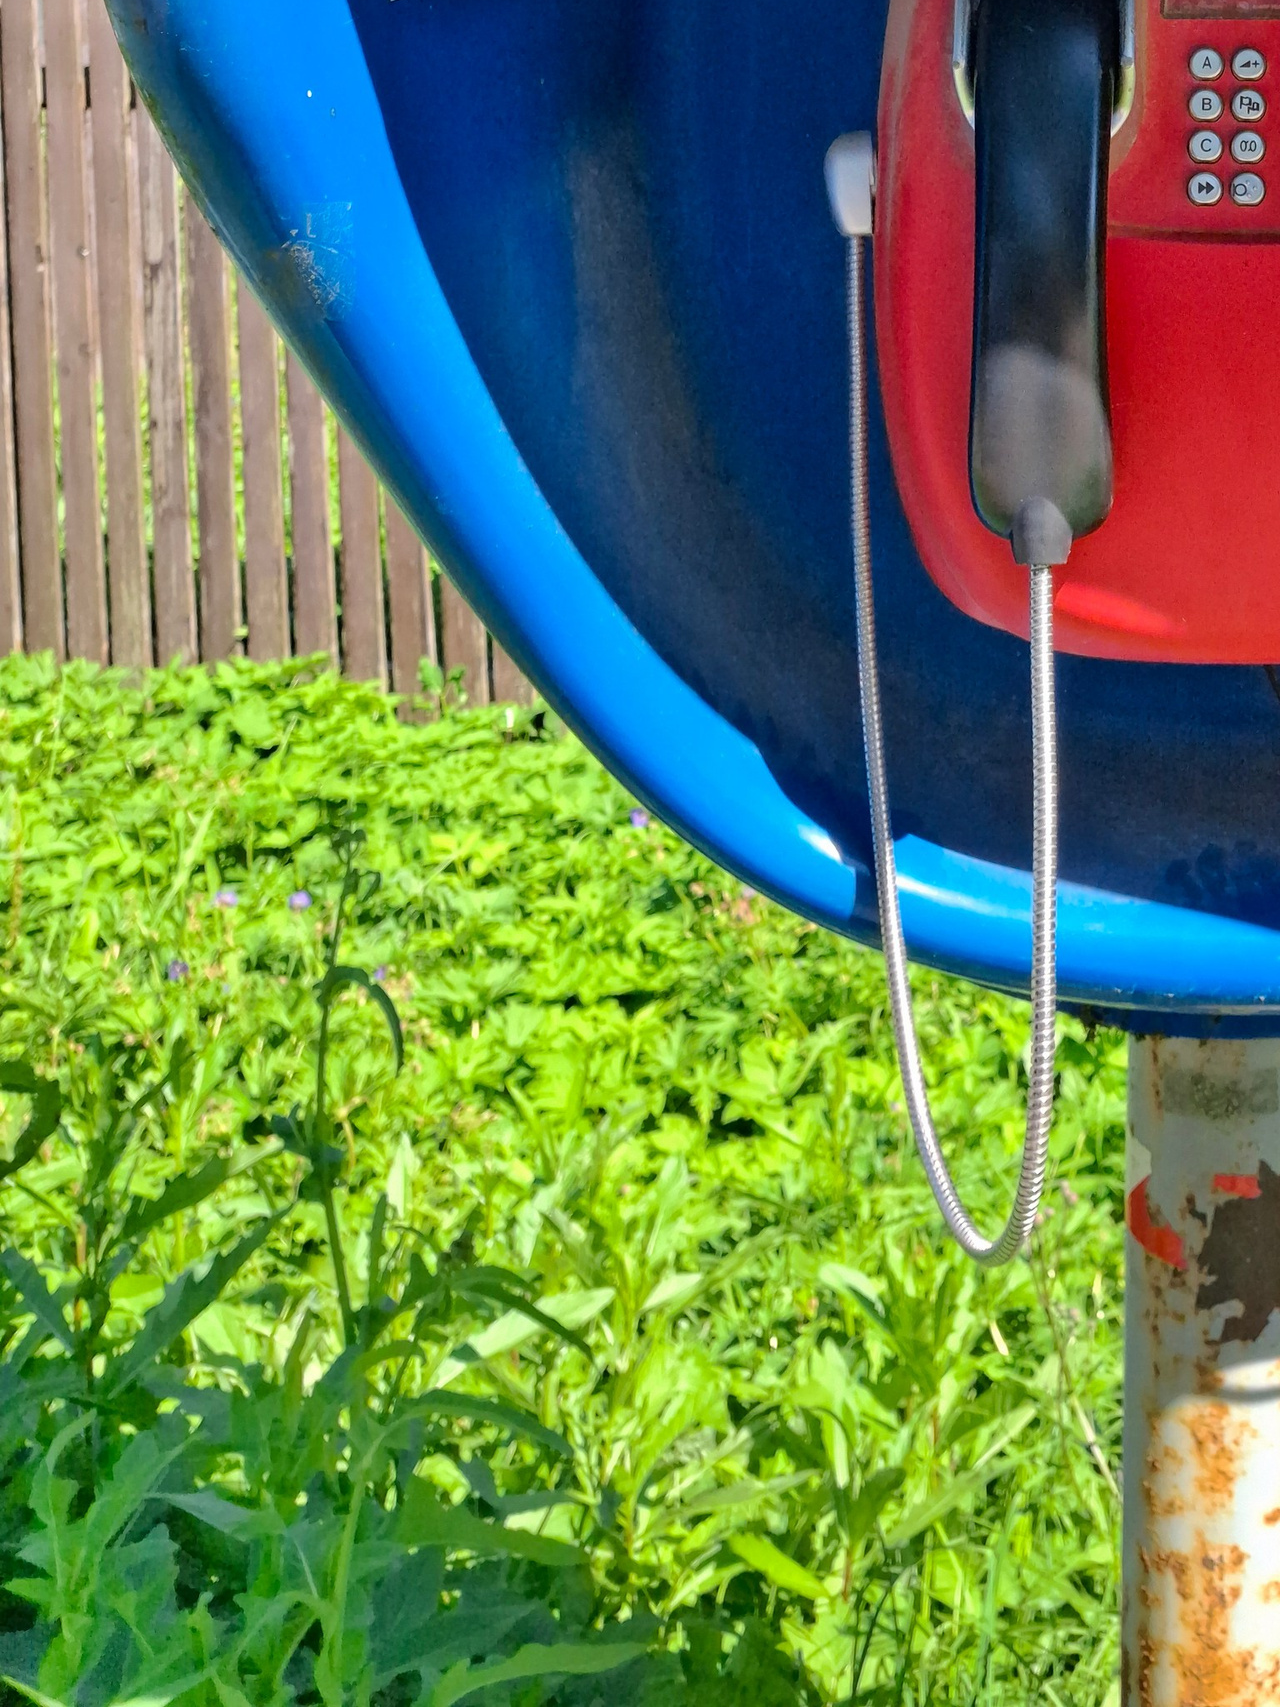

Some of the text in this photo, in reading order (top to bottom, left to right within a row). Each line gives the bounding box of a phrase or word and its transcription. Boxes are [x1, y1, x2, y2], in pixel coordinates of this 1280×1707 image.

[1202, 56, 1212, 70] A
[1202, 97, 1212, 111] B
[1200, 139, 1212, 153] C
